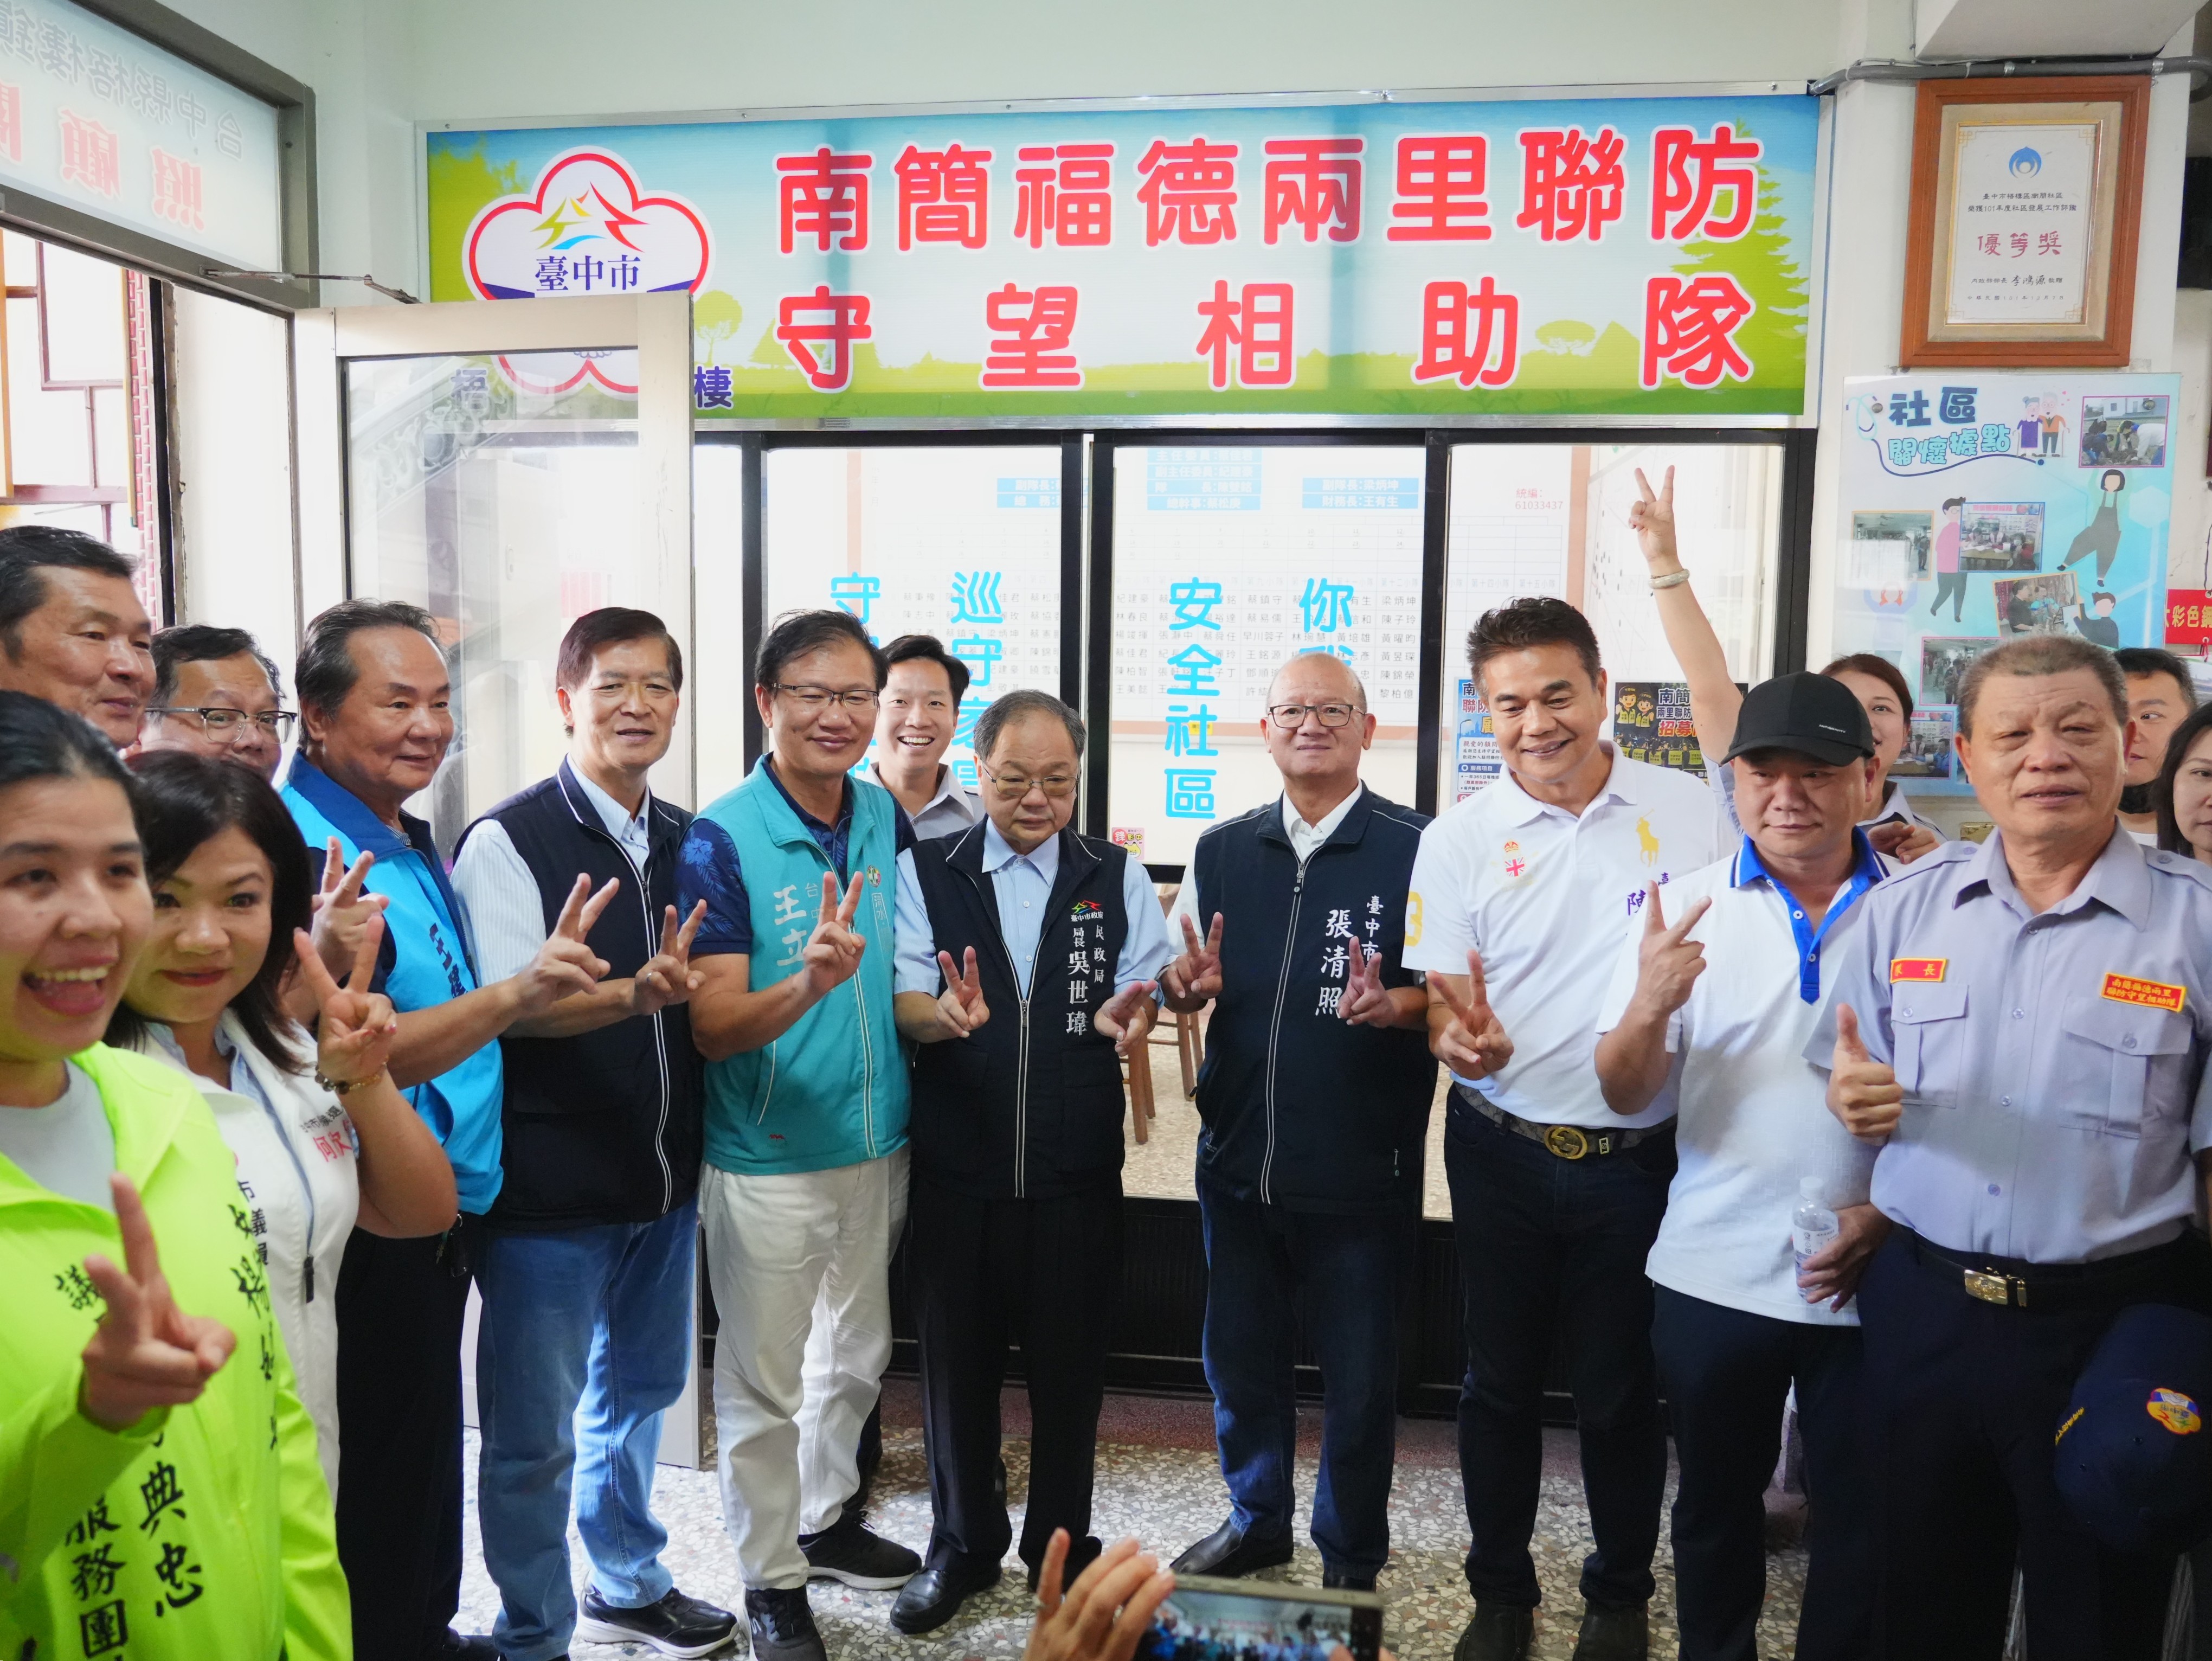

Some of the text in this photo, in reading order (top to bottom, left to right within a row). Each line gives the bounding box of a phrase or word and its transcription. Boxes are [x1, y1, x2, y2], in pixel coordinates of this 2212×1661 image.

[777, 127, 1759, 252] 南簡福德兩里聯防
[535, 254, 641, 292] 臺中市
[1977, 230, 2062, 258] 優等獎
[777, 277, 1750, 388] 守望相助隊
[1888, 386, 1978, 427] 社區
[1888, 424, 2011, 466] 關懷據點
[1515, 501, 1564, 510] 61033437
[1163, 576, 1223, 820] 安全社區
[1658, 720, 1697, 737] 招募
[773, 884, 807, 967] 王立
[1072, 927, 1085, 947] 局長
[1093, 925, 1107, 984] 民政局
[1362, 895, 1384, 963] 臺中市
[1315, 909, 1355, 1019] 張清照
[64, 1495, 128, 1661] 服務團
